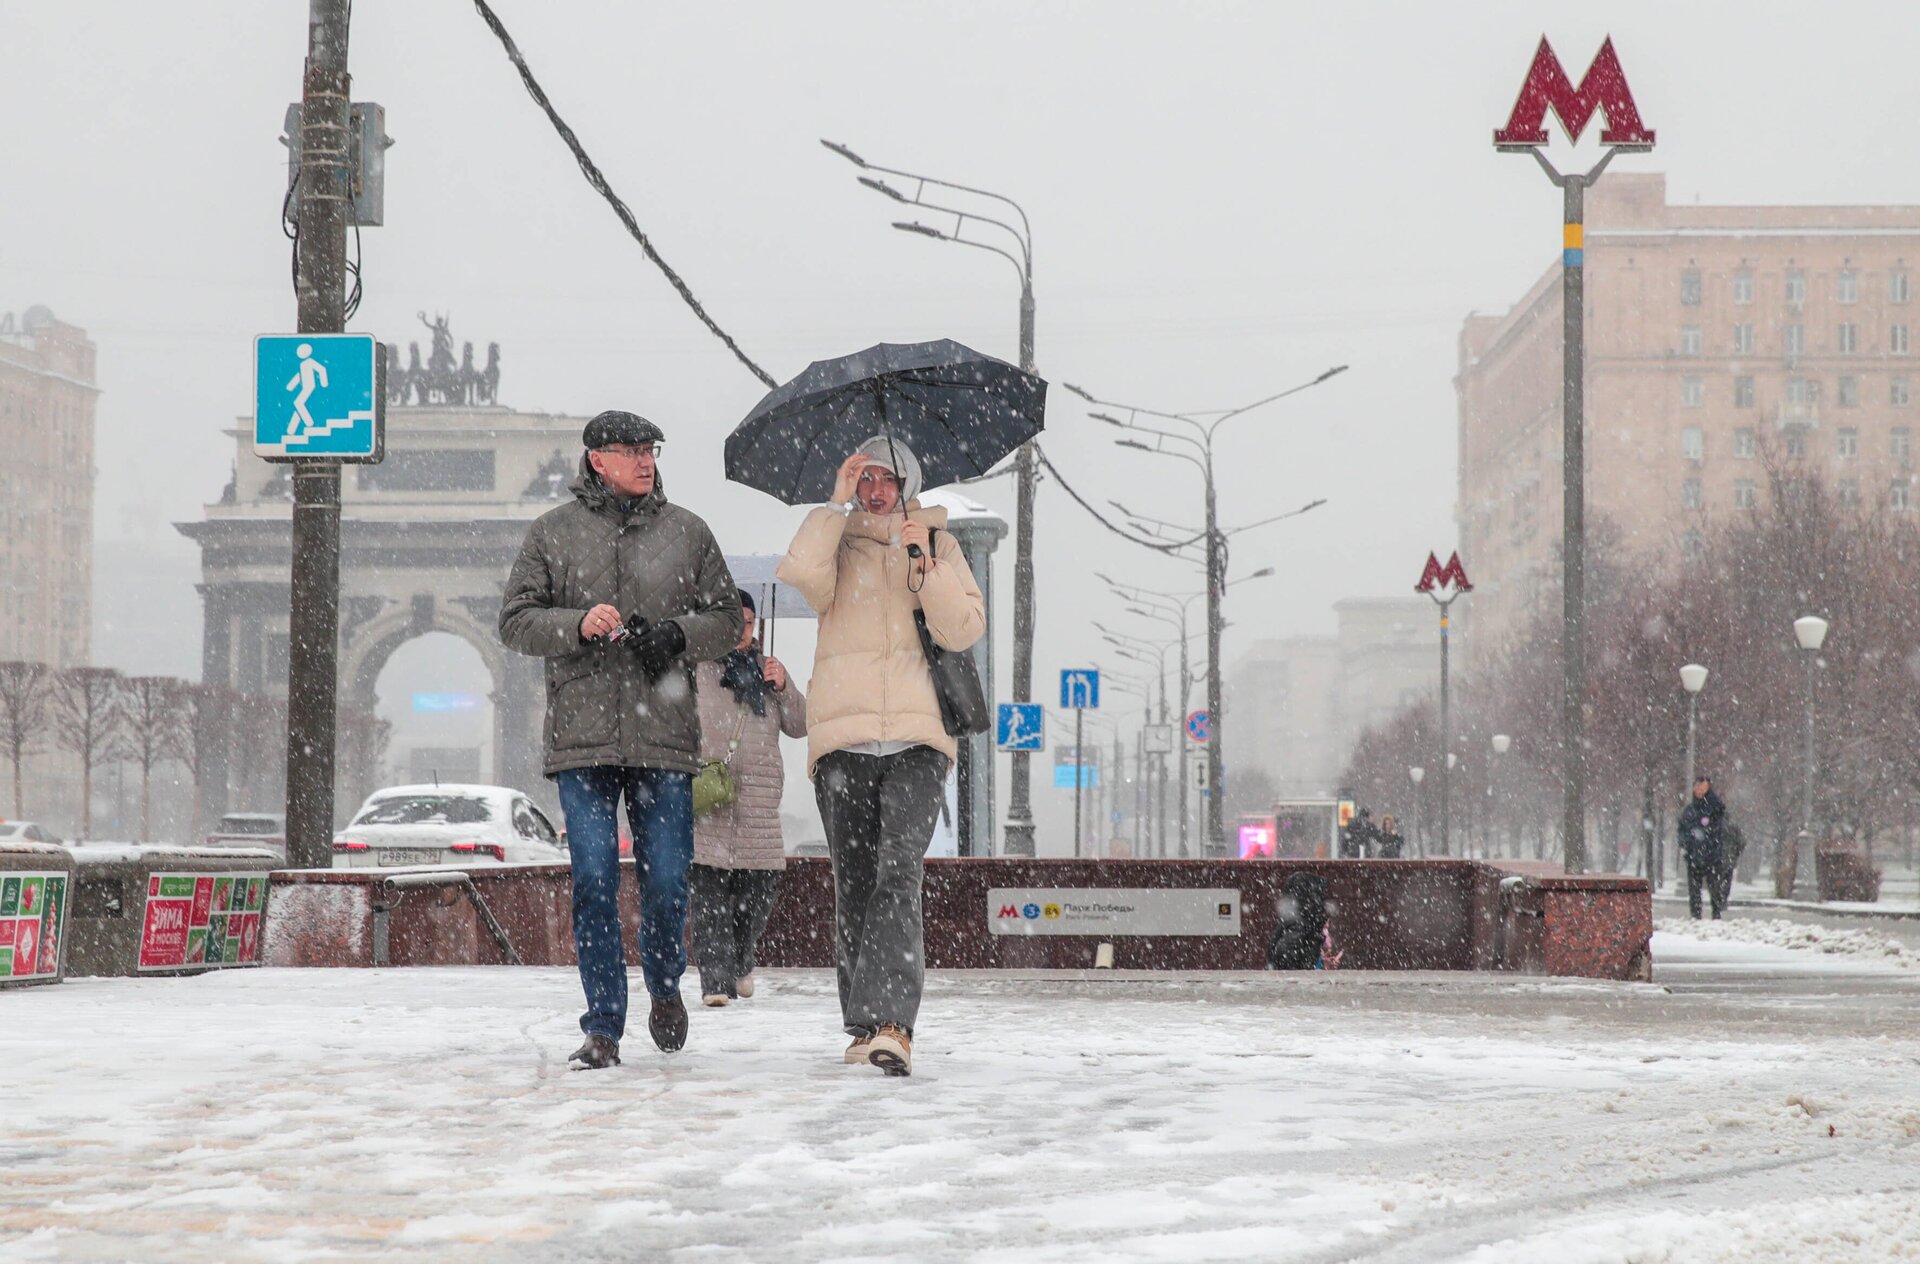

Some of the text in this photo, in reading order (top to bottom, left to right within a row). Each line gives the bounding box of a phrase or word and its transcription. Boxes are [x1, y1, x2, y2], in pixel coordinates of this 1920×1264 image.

[1493, 32, 1657, 147] М
[1414, 550, 1474, 591] М
[153, 907, 183, 929] ЗИМА
[1063, 903, 1090, 913] Парк
[1093, 903, 1135, 913] Победы
